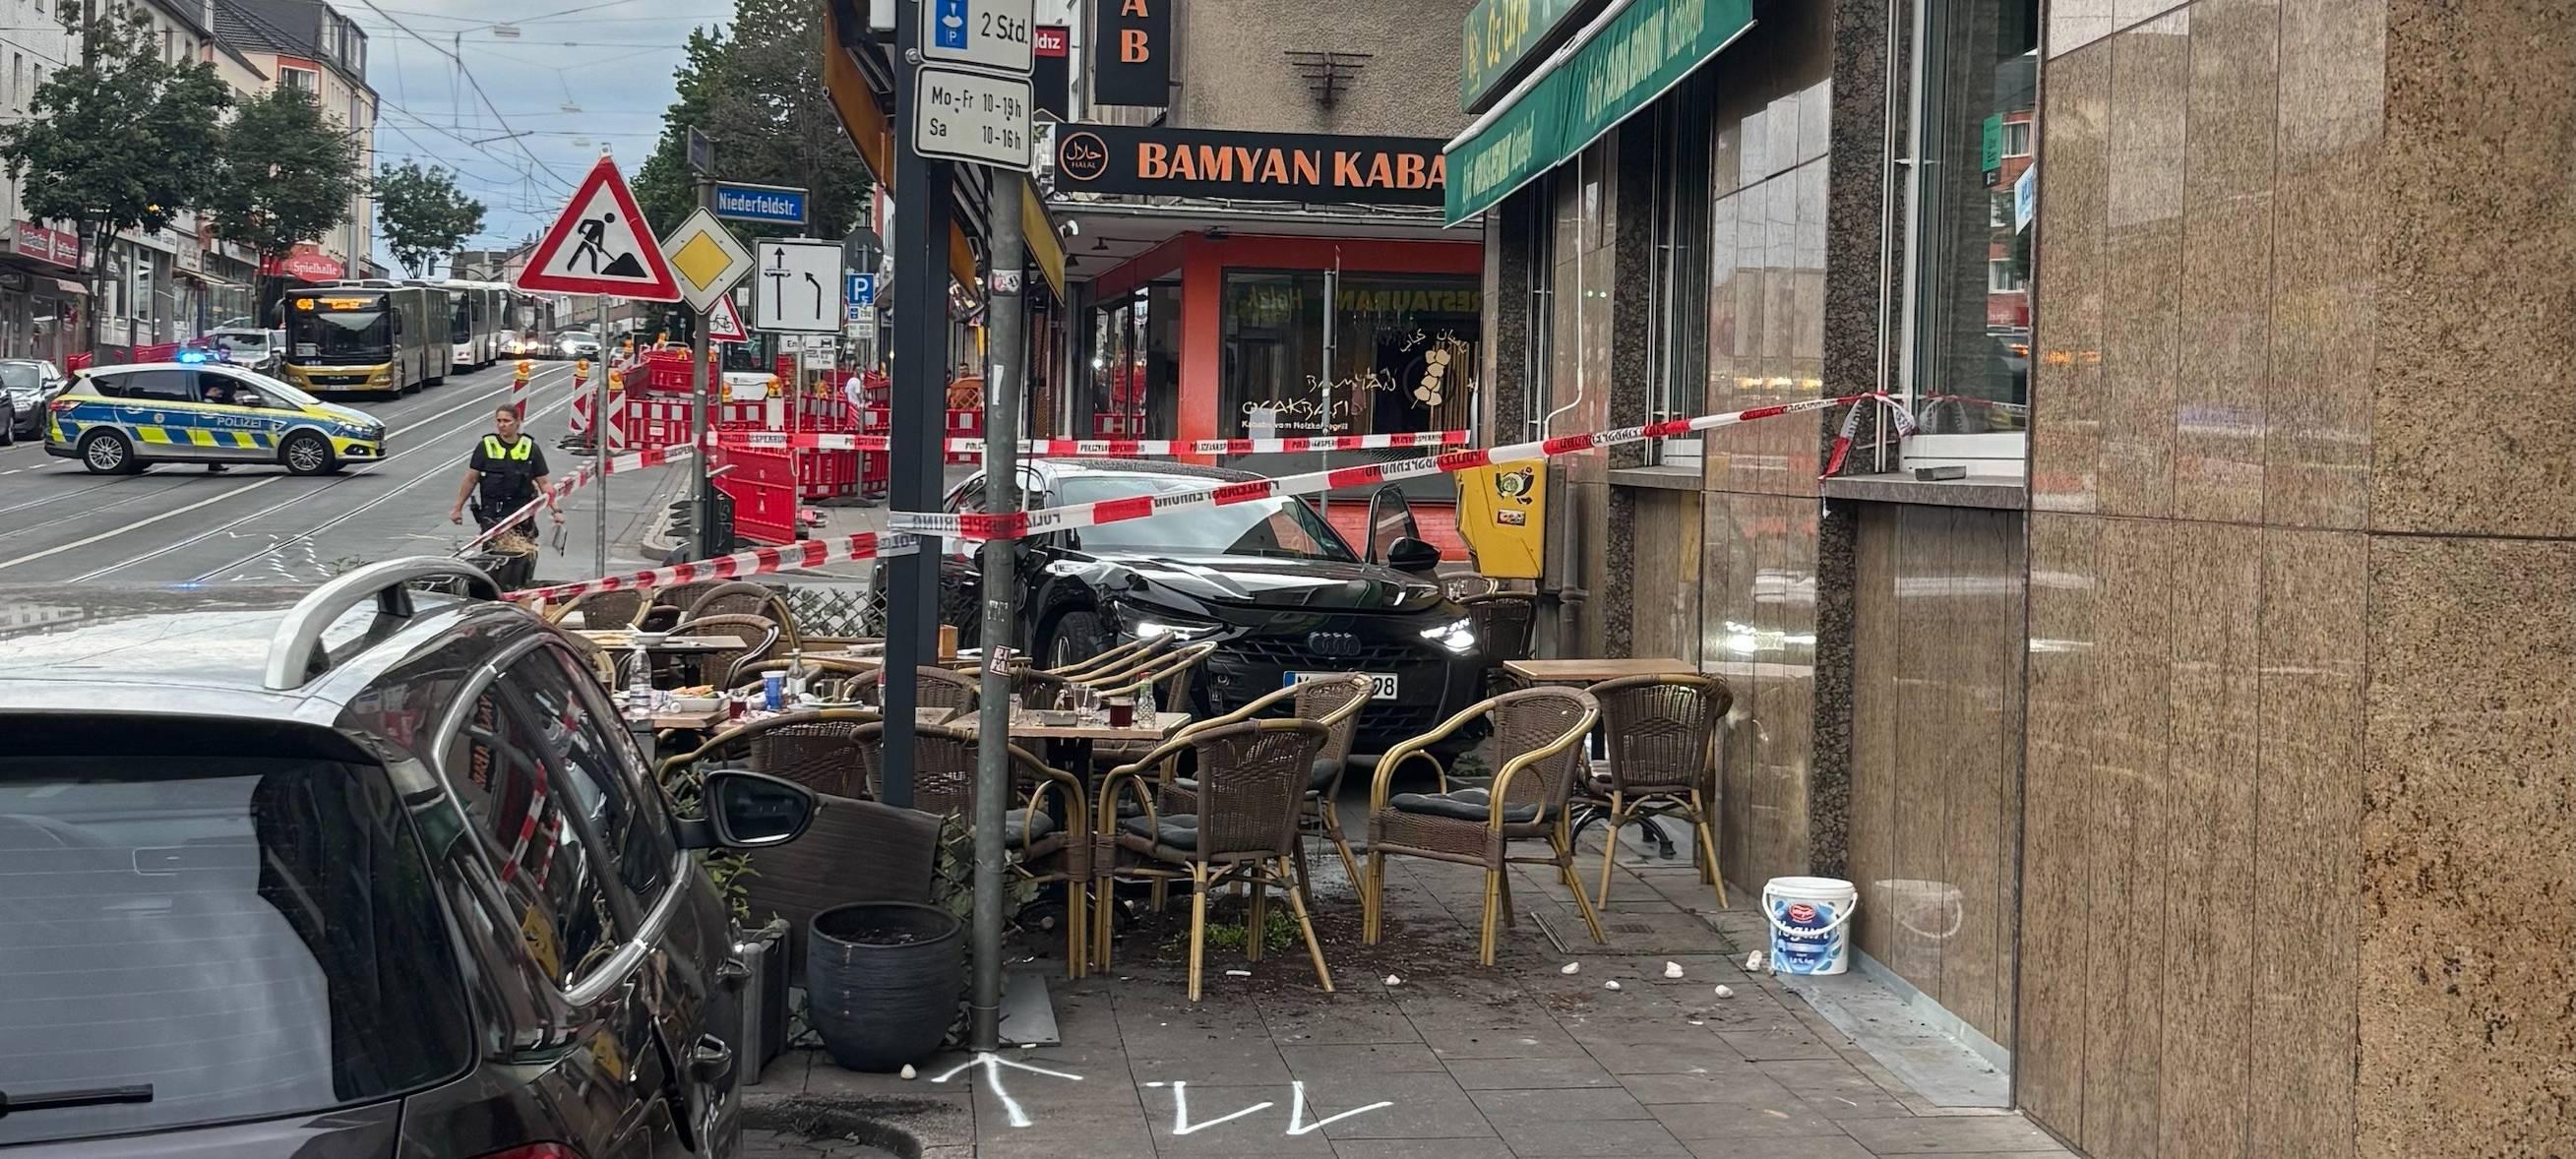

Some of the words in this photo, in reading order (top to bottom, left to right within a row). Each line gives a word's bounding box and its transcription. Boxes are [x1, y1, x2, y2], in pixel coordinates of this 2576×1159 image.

[981, 12, 991, 37] 2
[997, 15, 1028, 44] Std.
[929, 117, 947, 137] Sa
[1072, 161, 1096, 170] HALAL
[1137, 142, 1320, 185] BAMYAN
[718, 192, 797, 216] Niederfeldstr.
[293, 261, 337, 276] Spielhalle
[854, 277, 869, 301] P
[1306, 369, 1397, 393] BAMYAN
[216, 416, 262, 428] POLIZEI
